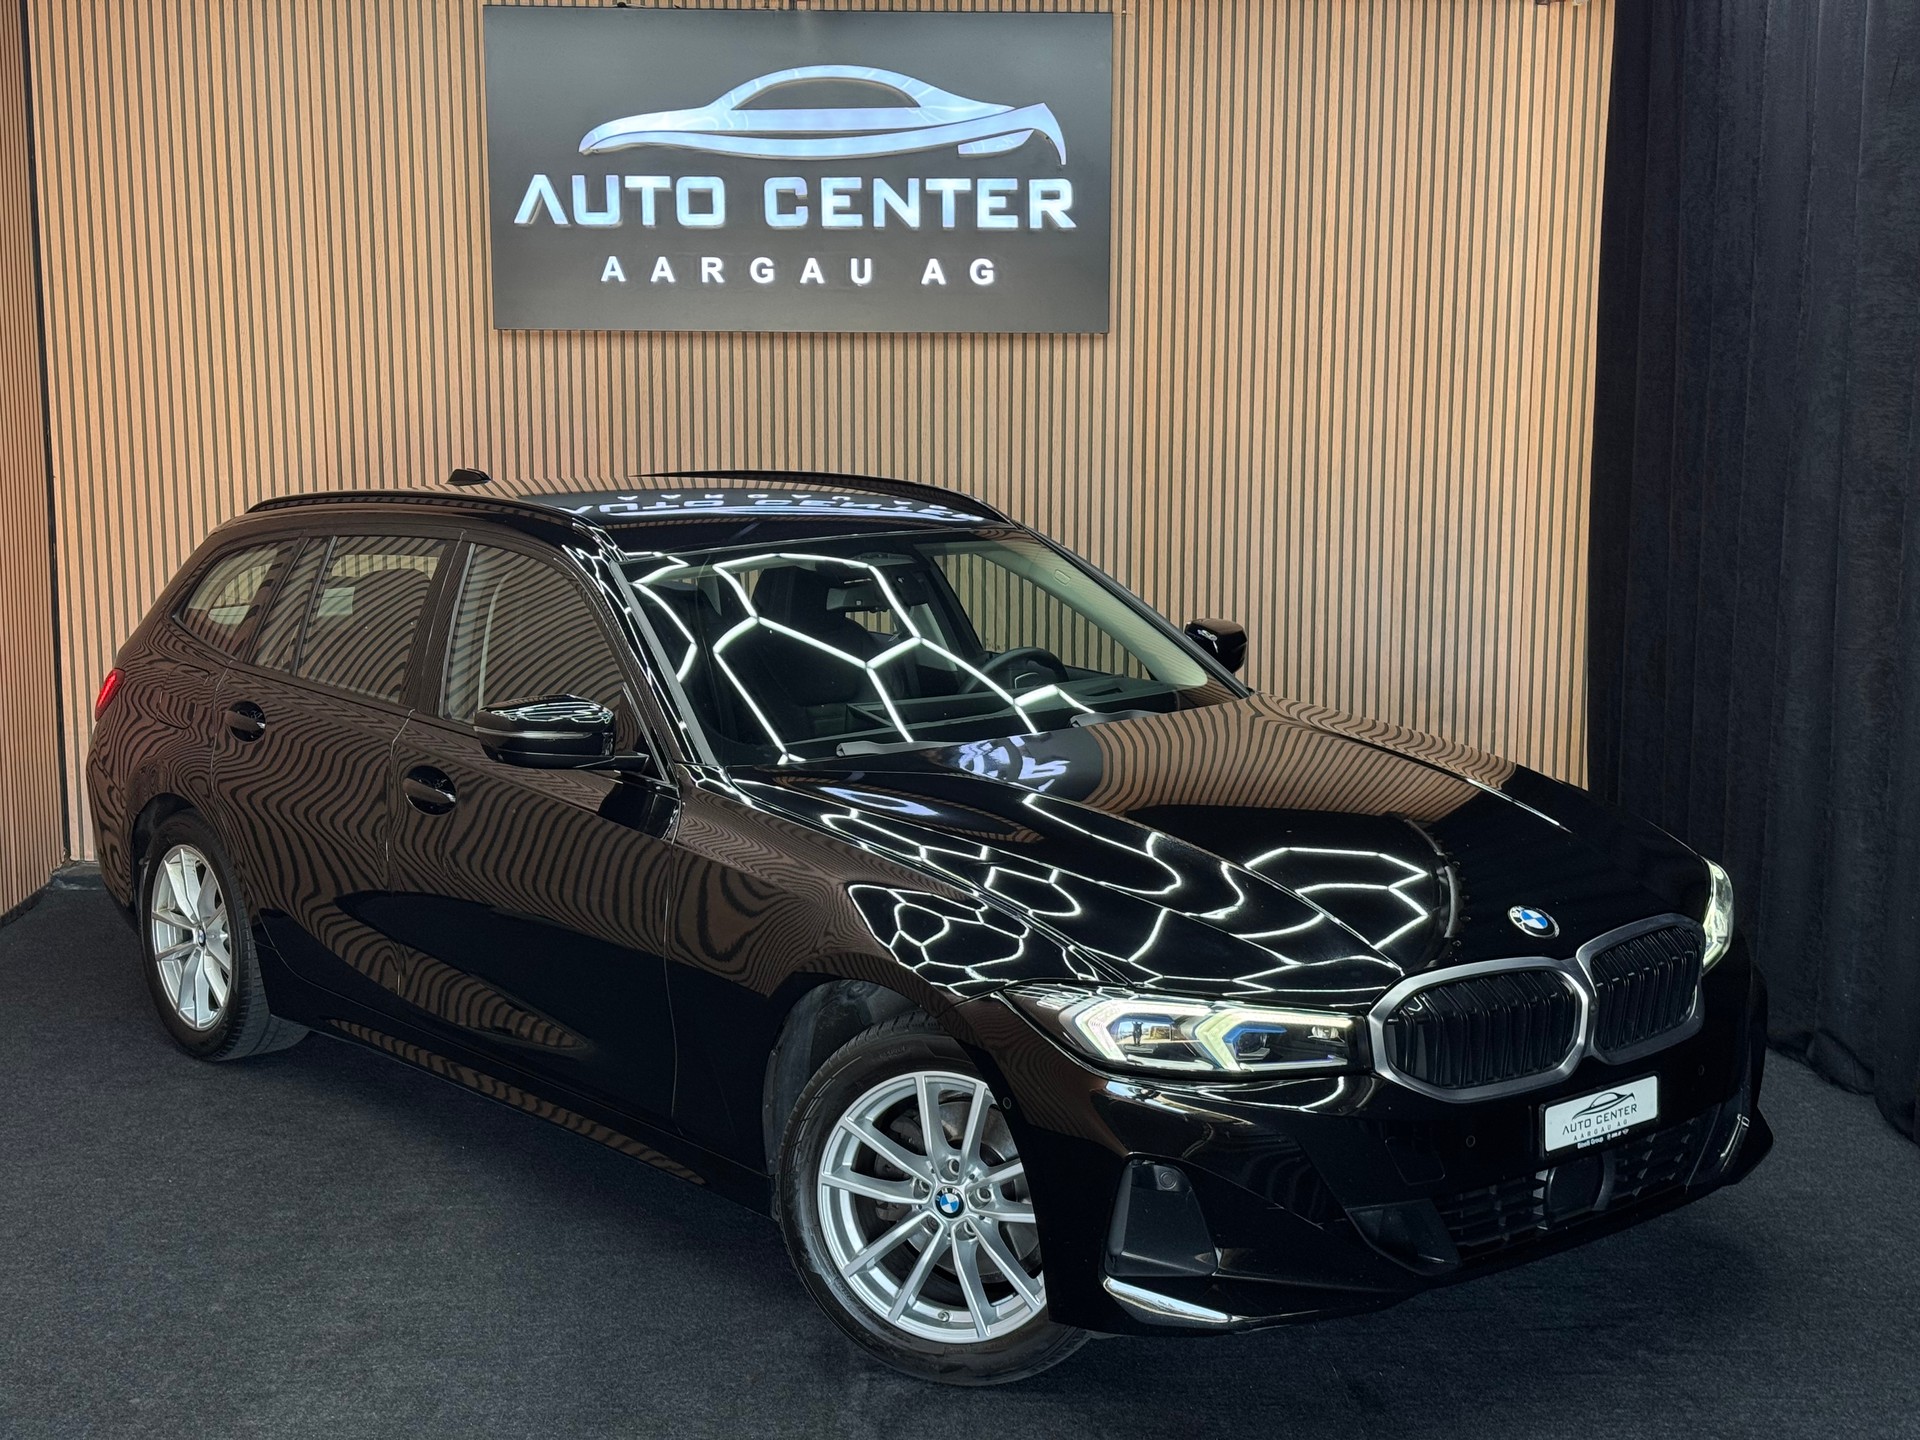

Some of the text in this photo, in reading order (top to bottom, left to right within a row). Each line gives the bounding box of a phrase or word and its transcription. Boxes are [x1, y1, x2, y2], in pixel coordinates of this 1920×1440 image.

[513, 174, 1077, 230] AUTO CENTER
[600, 255, 996, 286] AARGAU AG
[1562, 1118, 1592, 1136] AUTO
[1595, 1103, 1638, 1125] CENTER
[1573, 1122, 1612, 1141] AARGAU
